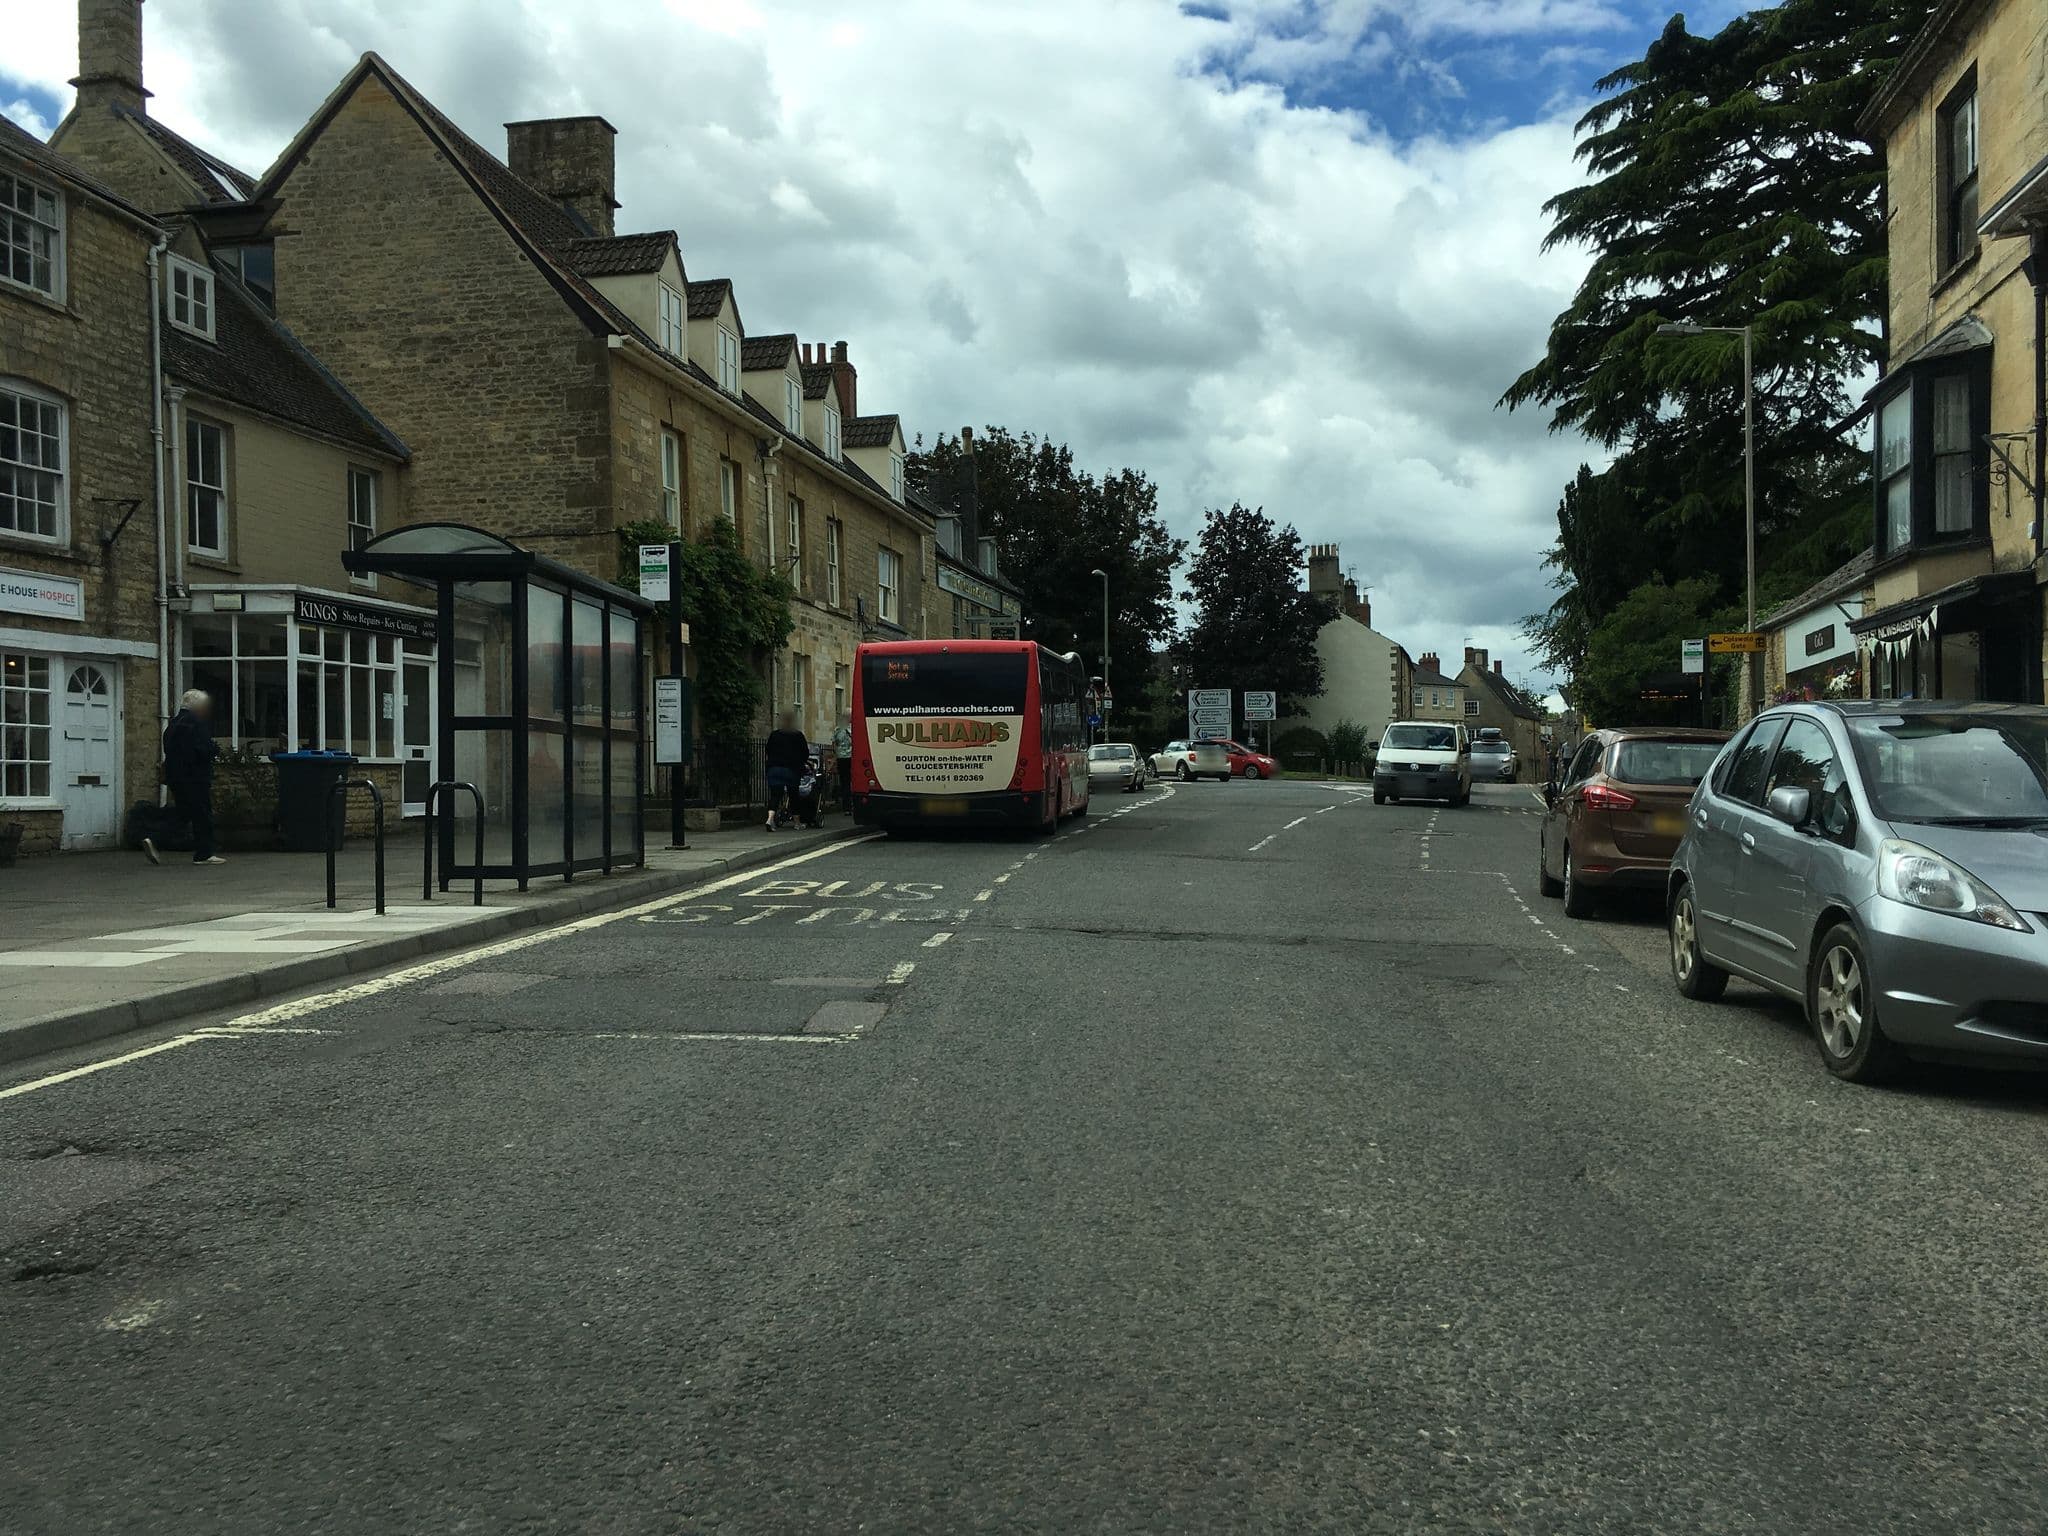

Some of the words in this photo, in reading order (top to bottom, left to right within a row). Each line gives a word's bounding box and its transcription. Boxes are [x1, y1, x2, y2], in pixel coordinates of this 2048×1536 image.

[8, 585, 38, 598] HOUSE
[39, 590, 76, 603] HOSPICE
[299, 601, 338, 621] KINGS
[342, 610, 358, 622] Shoe
[359, 613, 381, 626] Repairs
[384, 617, 395, 630] Key
[396, 620, 418, 633] Cutting
[1878, 615, 1922, 639] NEWSAGENTS
[888, 661, 900, 671] Not
[87, 692, 91, 701] 8
[873, 704, 1015, 715] www.pulhamscoaches.com
[877, 721, 1010, 744] PULHAMS
[895, 755, 936, 763] BOURTON
[938, 755, 993, 763] on-the-WATER
[738, 880, 943, 901] BUS
